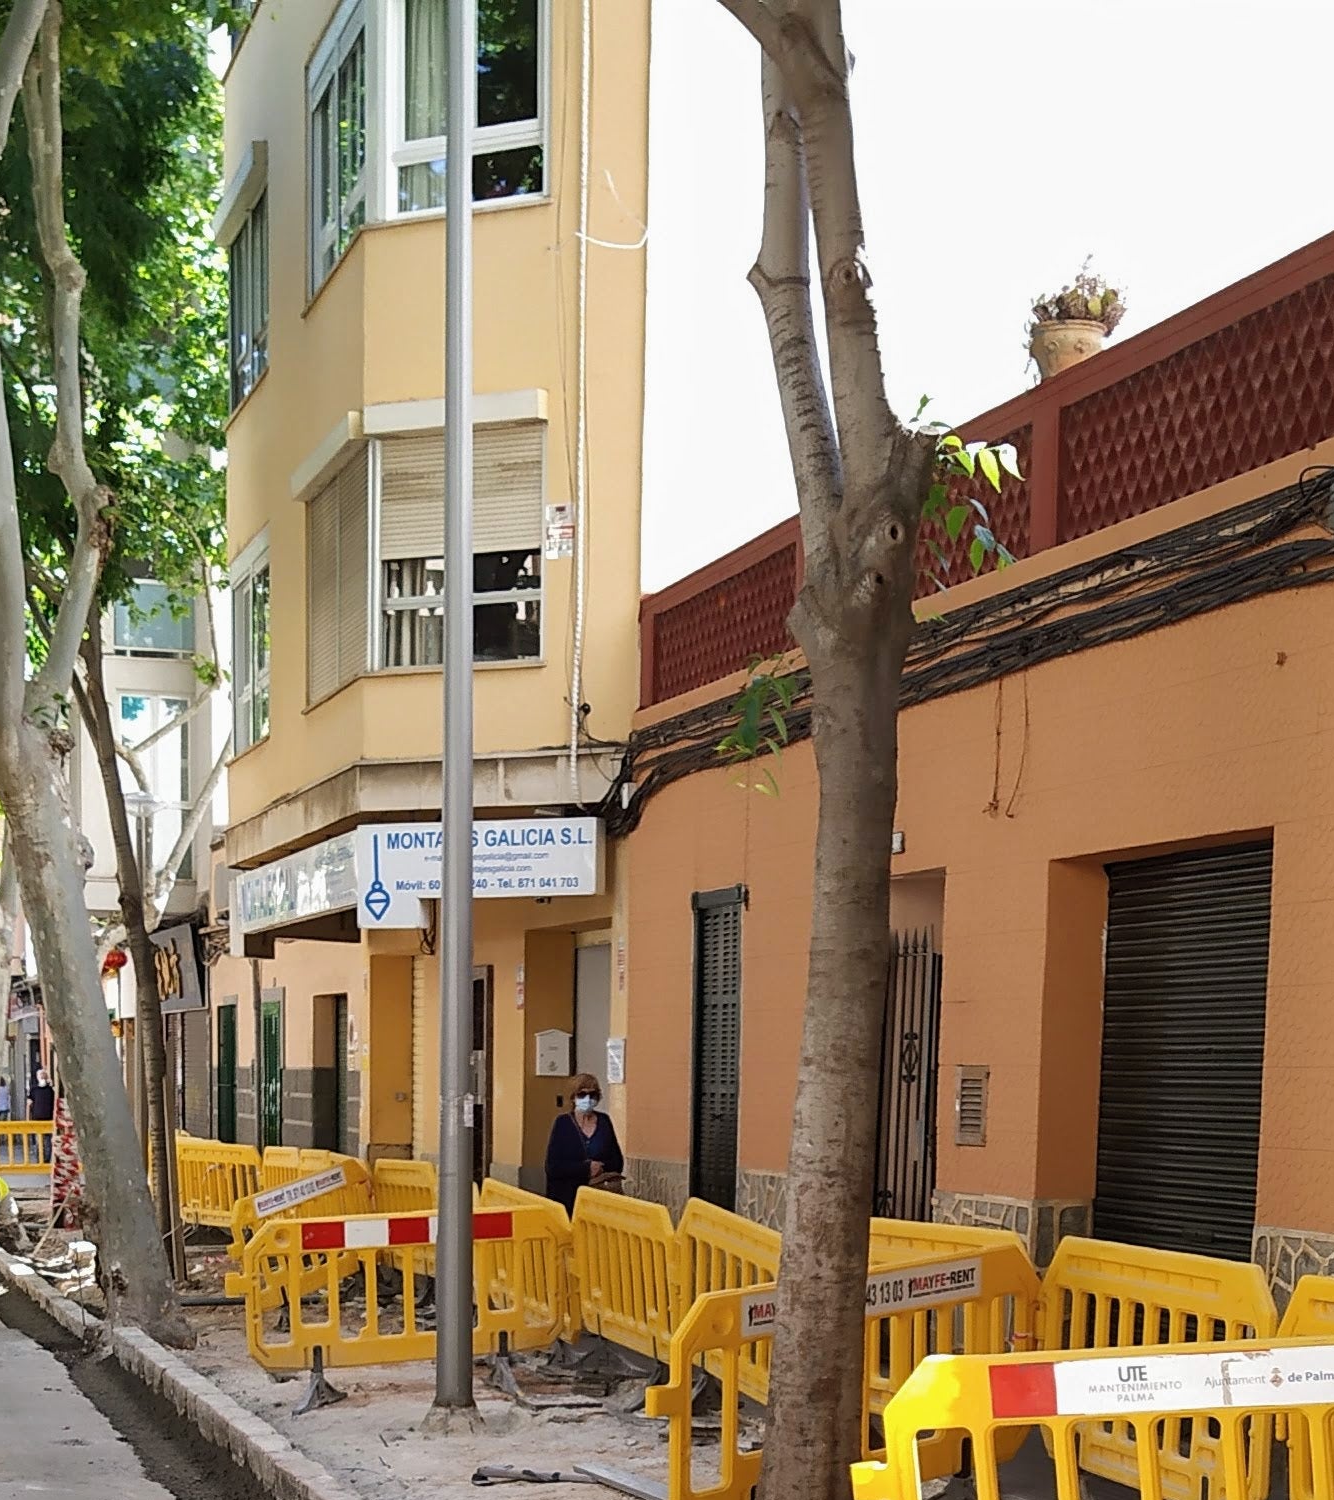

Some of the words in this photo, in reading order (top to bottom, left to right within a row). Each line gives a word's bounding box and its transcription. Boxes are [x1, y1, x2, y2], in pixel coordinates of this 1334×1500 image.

[387, 831, 478, 850] MONTAS
[484, 828, 555, 848] GALICIA
[560, 827, 593, 845] S.L.
[518, 877, 535, 888] 871
[539, 877, 557, 888] 041
[560, 876, 579, 888] 703
[880, 1281, 891, 1304] 13
[892, 1279, 904, 1303] 03
[913, 1267, 976, 1291] MAYFE-RENT
[1118, 1365, 1148, 1383] UTE
[1204, 1374, 1267, 1390] Ajuntament
[1287, 1372, 1303, 1383] de
[1088, 1380, 1183, 1395] MANTENIMIENTO
[1117, 1391, 1155, 1403] PALMA
